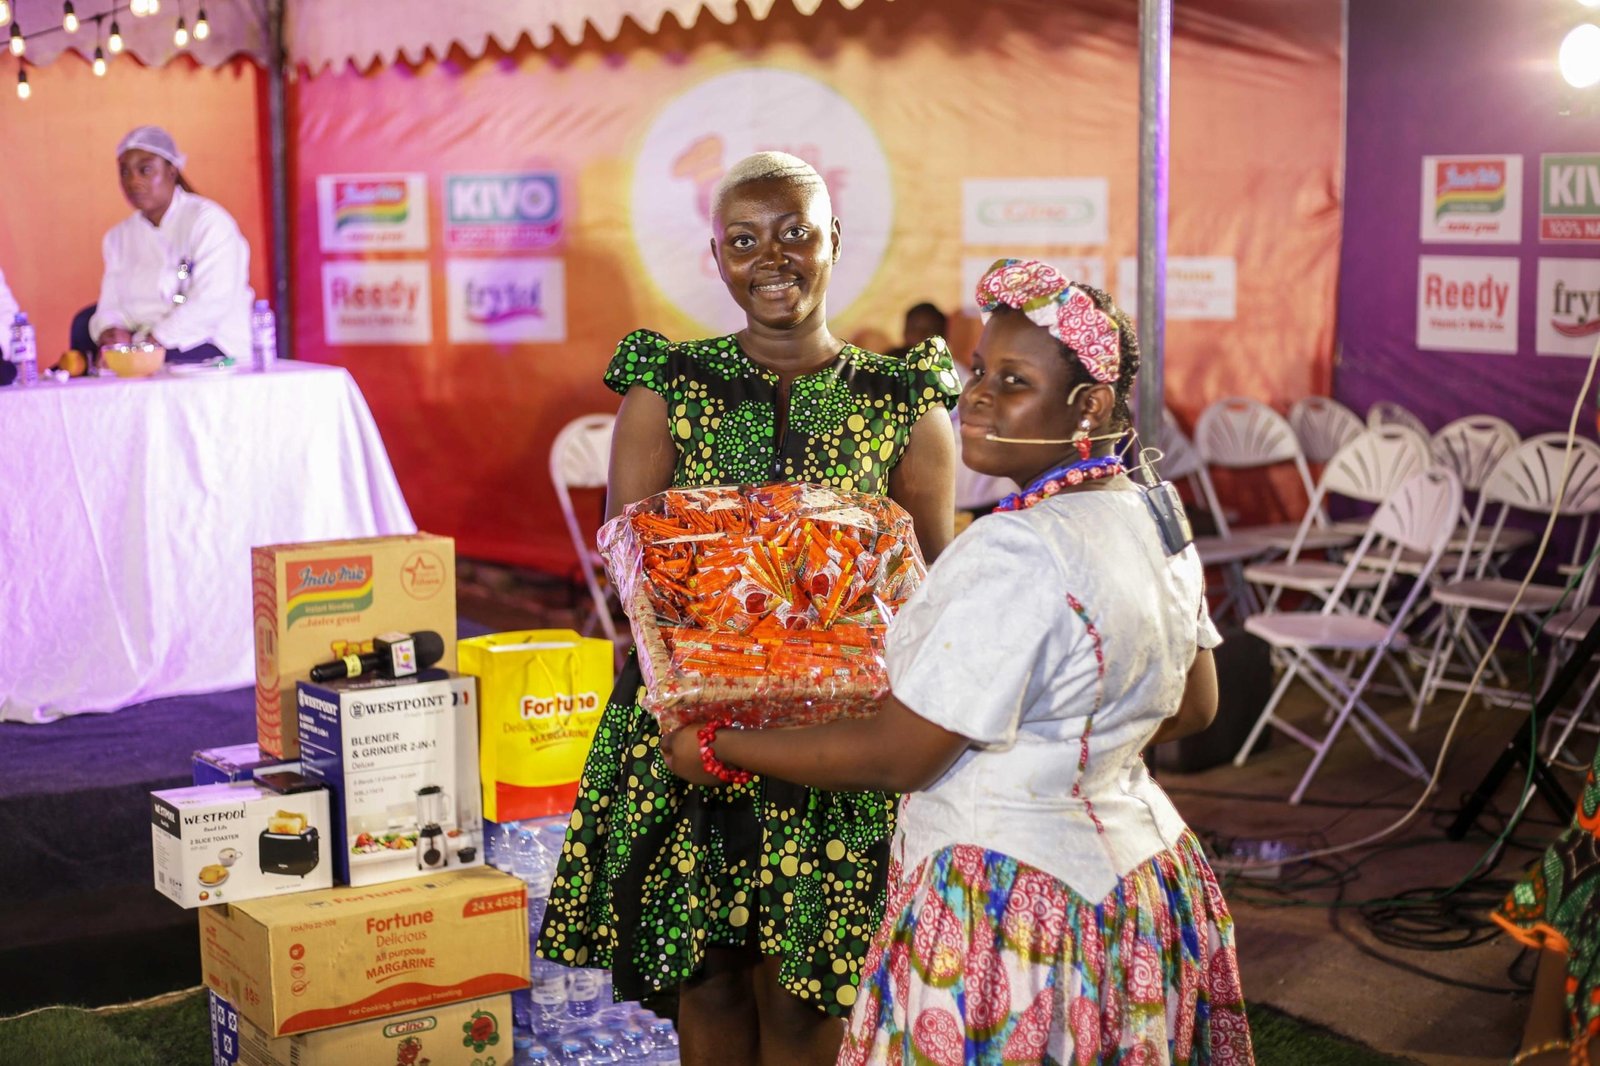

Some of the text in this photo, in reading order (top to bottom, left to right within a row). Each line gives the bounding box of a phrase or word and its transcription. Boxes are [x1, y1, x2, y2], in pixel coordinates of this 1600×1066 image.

[1550, 165, 1600, 206] KIV
[454, 181, 552, 217] KIVO
[1426, 273, 1510, 319] Reedy
[1554, 280, 1600, 325] fry
[366, 694, 445, 715] WESTPOINT
[351, 732, 400, 746] BLENDER
[351, 750, 359, 759] &
[361, 743, 408, 759] GRINDER
[366, 910, 434, 935] Fortune
[376, 931, 428, 948] Delicious
[388, 948, 426, 961] purpose
[366, 957, 436, 979] MARGARINE
[348, 1007, 359, 1016] For
[395, 1022, 425, 1035] Gino
